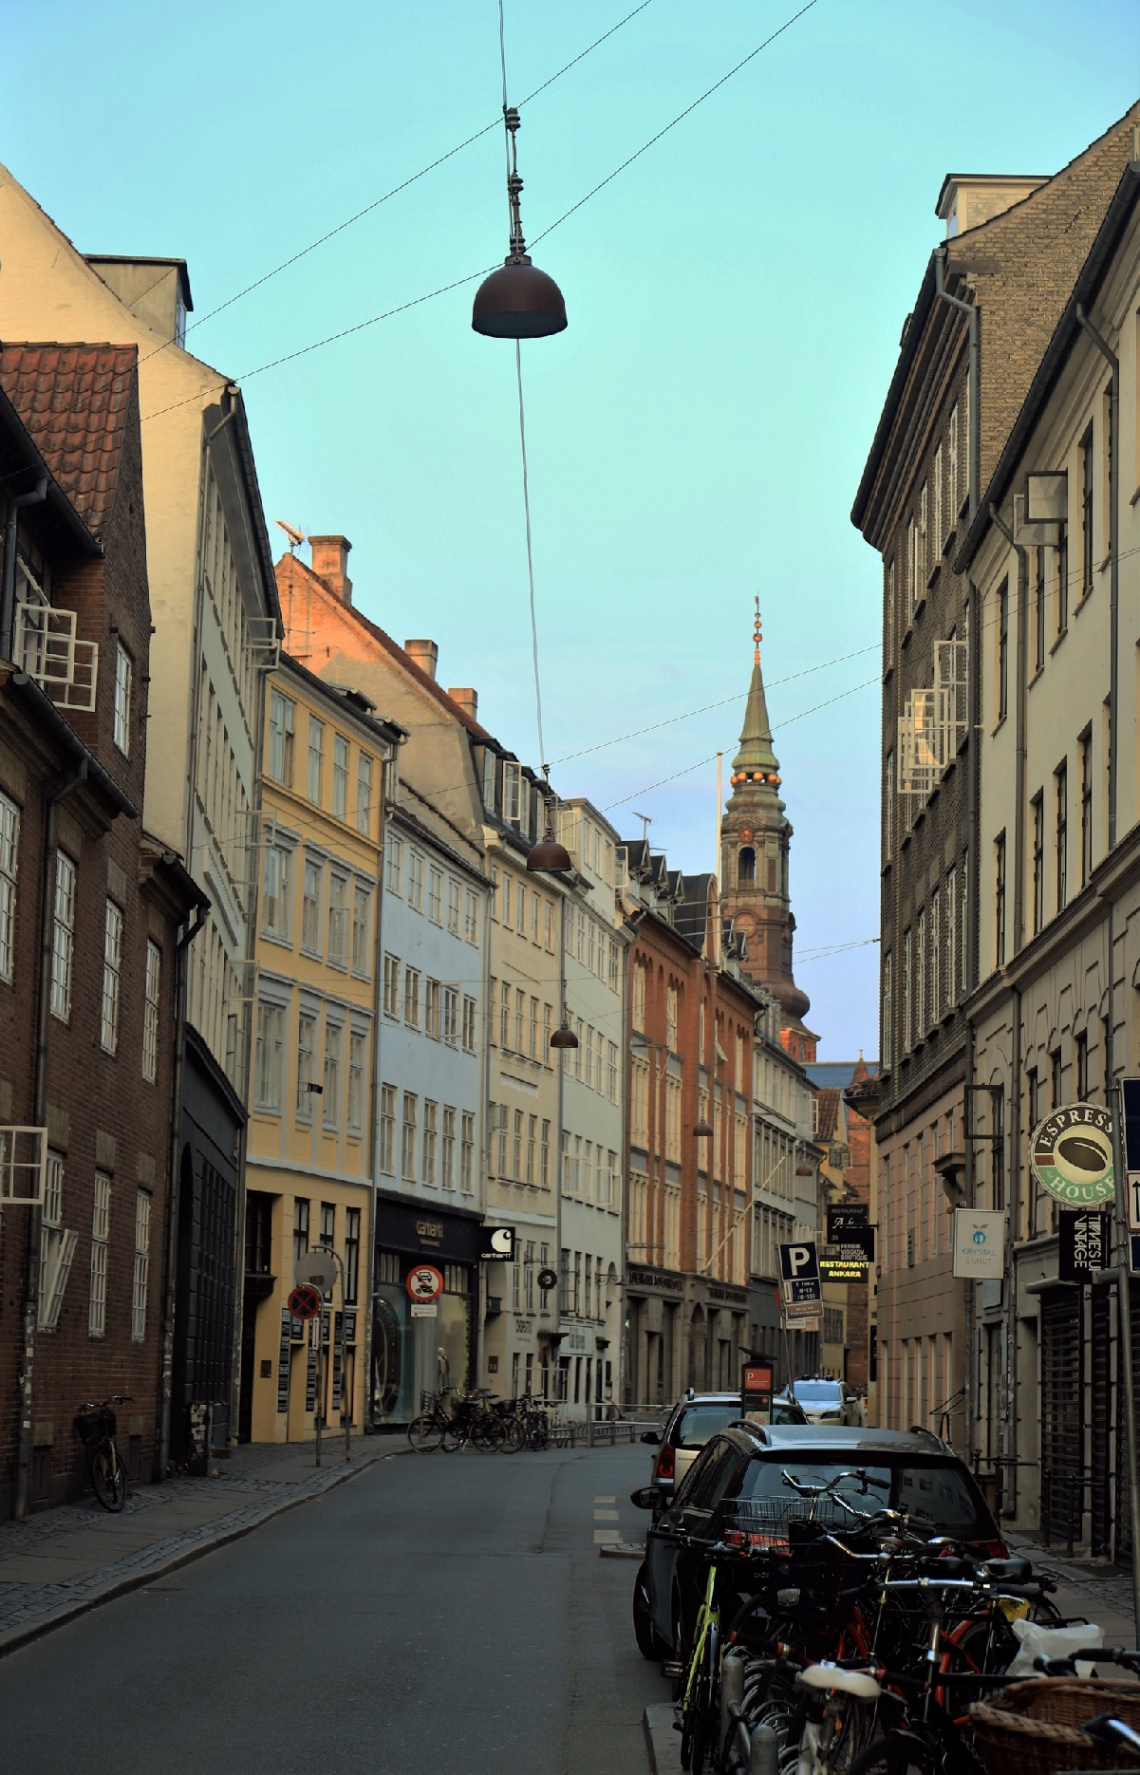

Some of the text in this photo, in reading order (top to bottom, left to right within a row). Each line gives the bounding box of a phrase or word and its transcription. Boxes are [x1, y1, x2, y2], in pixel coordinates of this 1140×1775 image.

[1039, 1109, 1114, 1148] ESPRESS
[1074, 1214, 1087, 1269] VINTAGE
[961, 1247, 997, 1257] KRYSTAL
[788, 1247, 811, 1276] P
[819, 1260, 869, 1269] RESTAURANT
[828, 1270, 862, 1278] ANKARA
[747, 1372, 755, 1382] P
